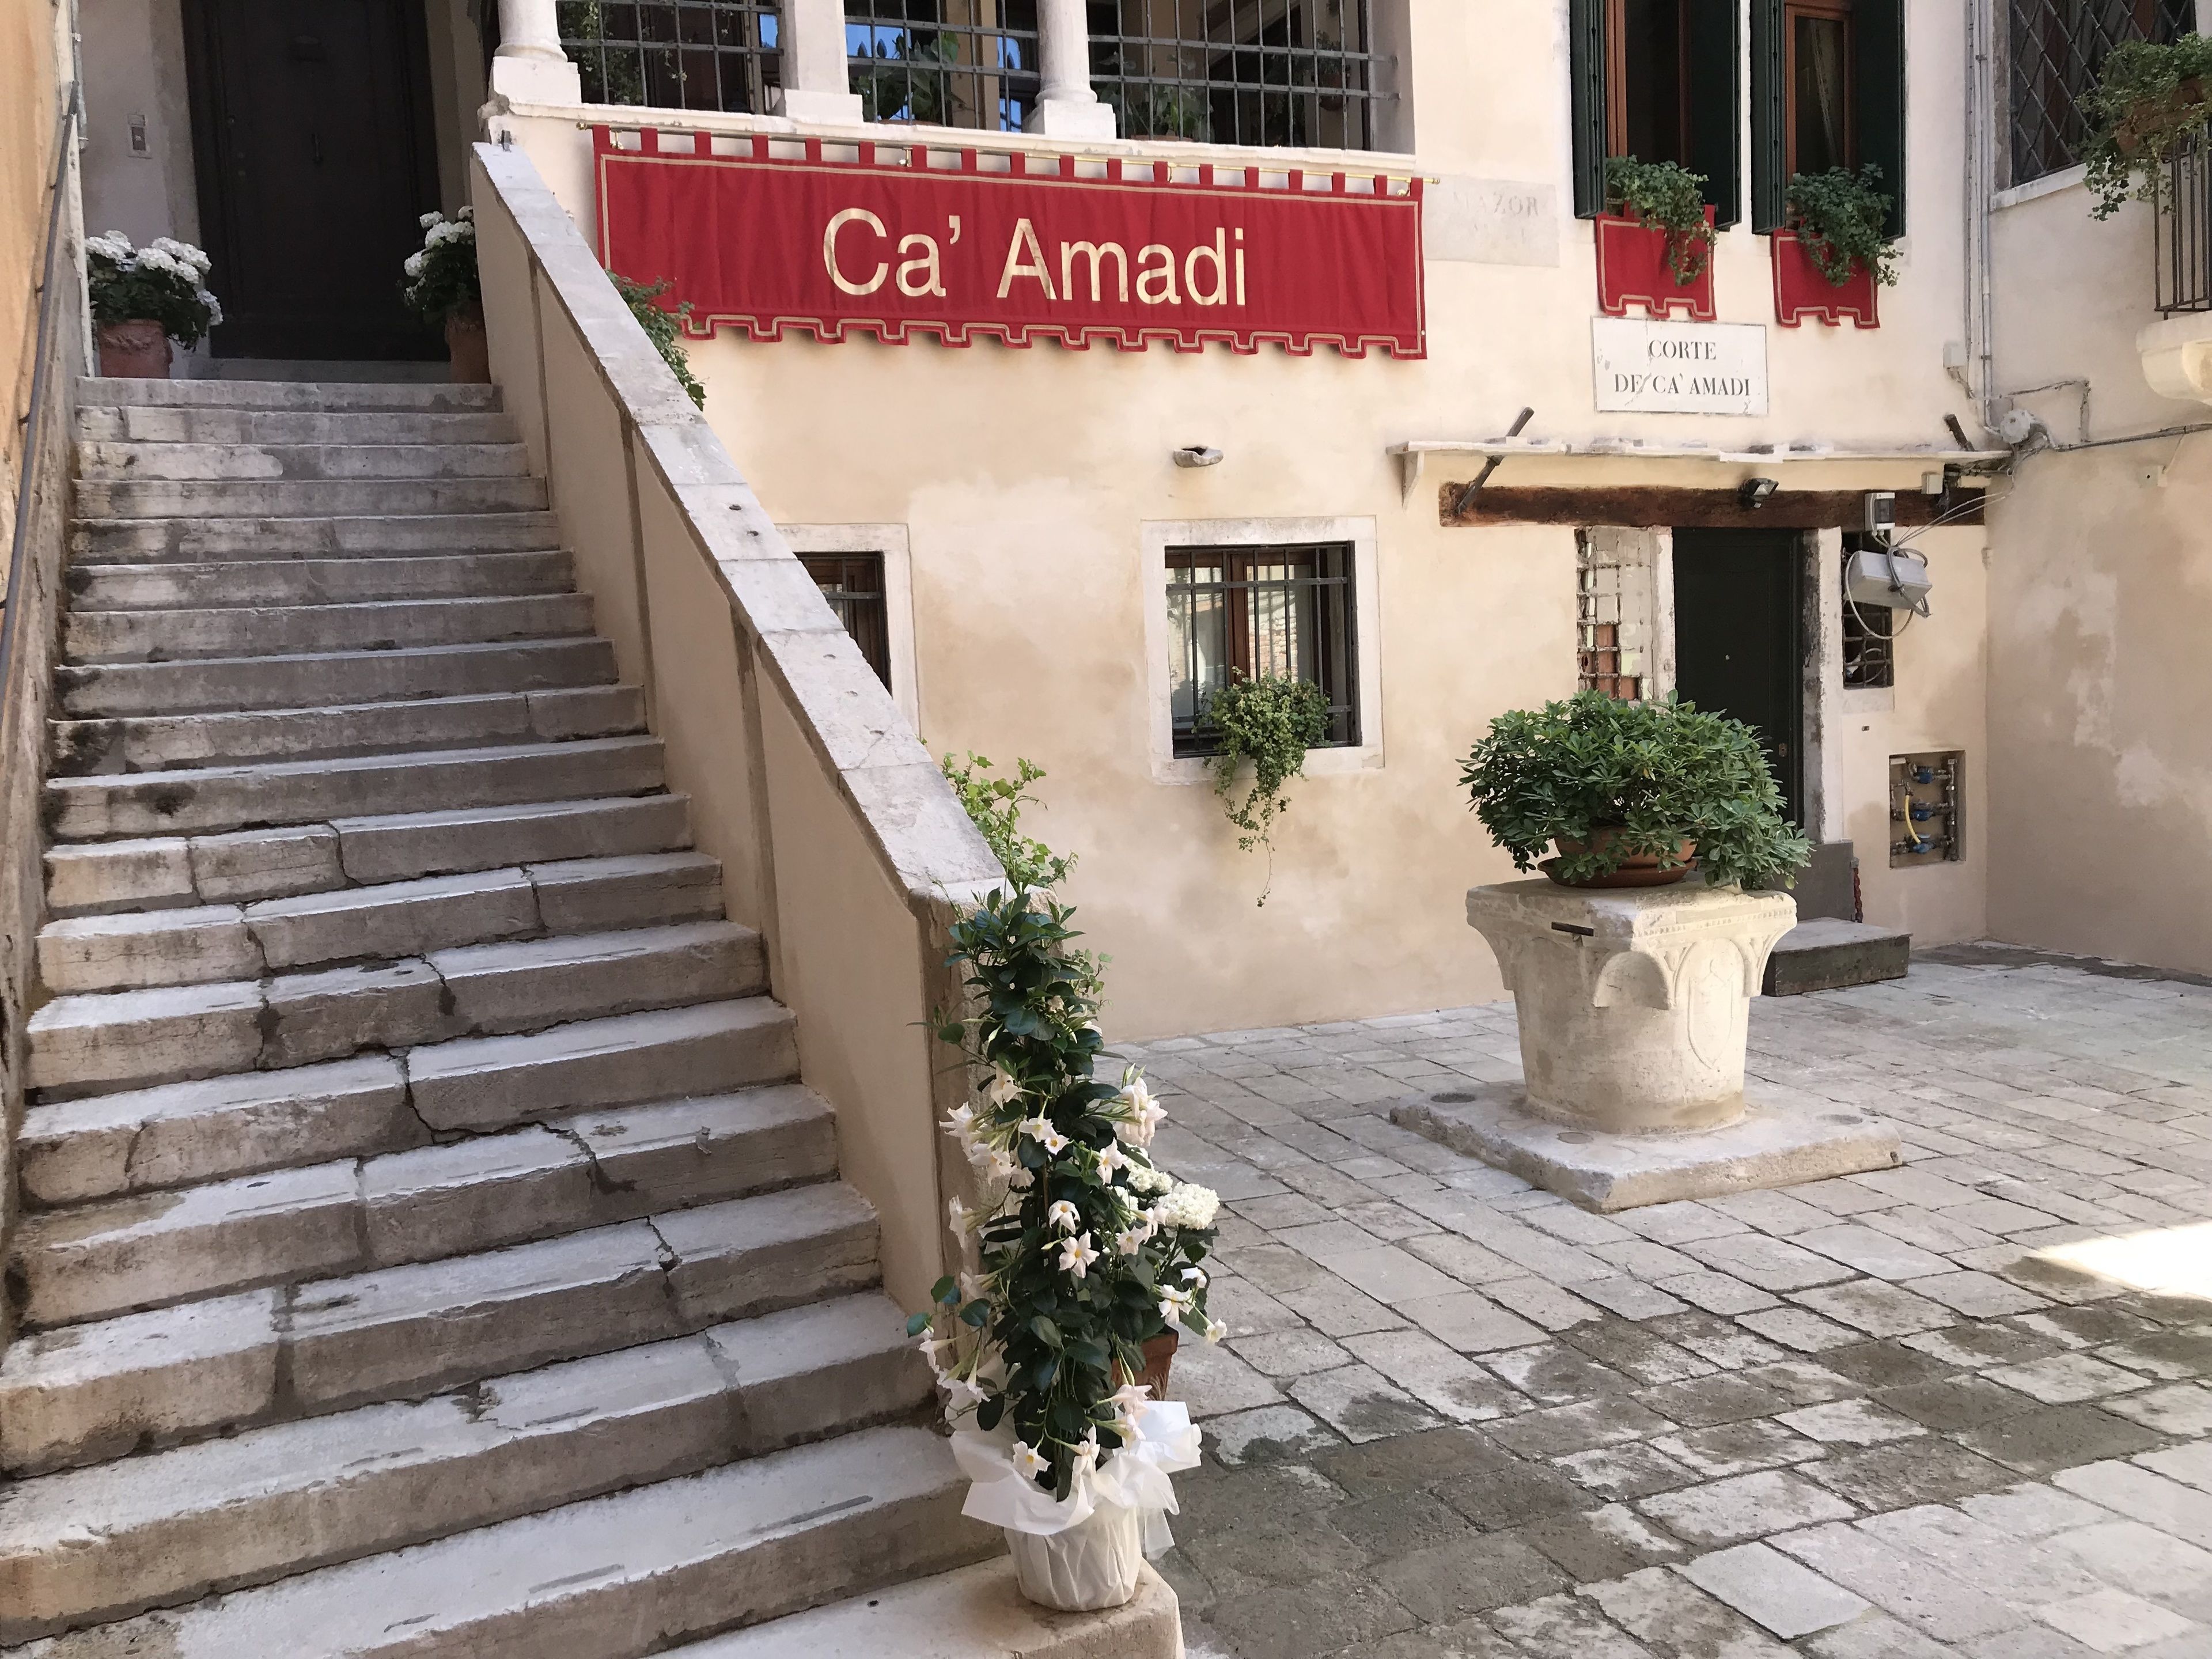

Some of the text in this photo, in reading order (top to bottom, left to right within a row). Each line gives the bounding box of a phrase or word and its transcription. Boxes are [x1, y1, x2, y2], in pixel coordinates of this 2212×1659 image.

[996, 217, 1246, 306] Amadi
[1648, 339, 1716, 360] CORTE
[1689, 376, 1751, 396] AMADI
